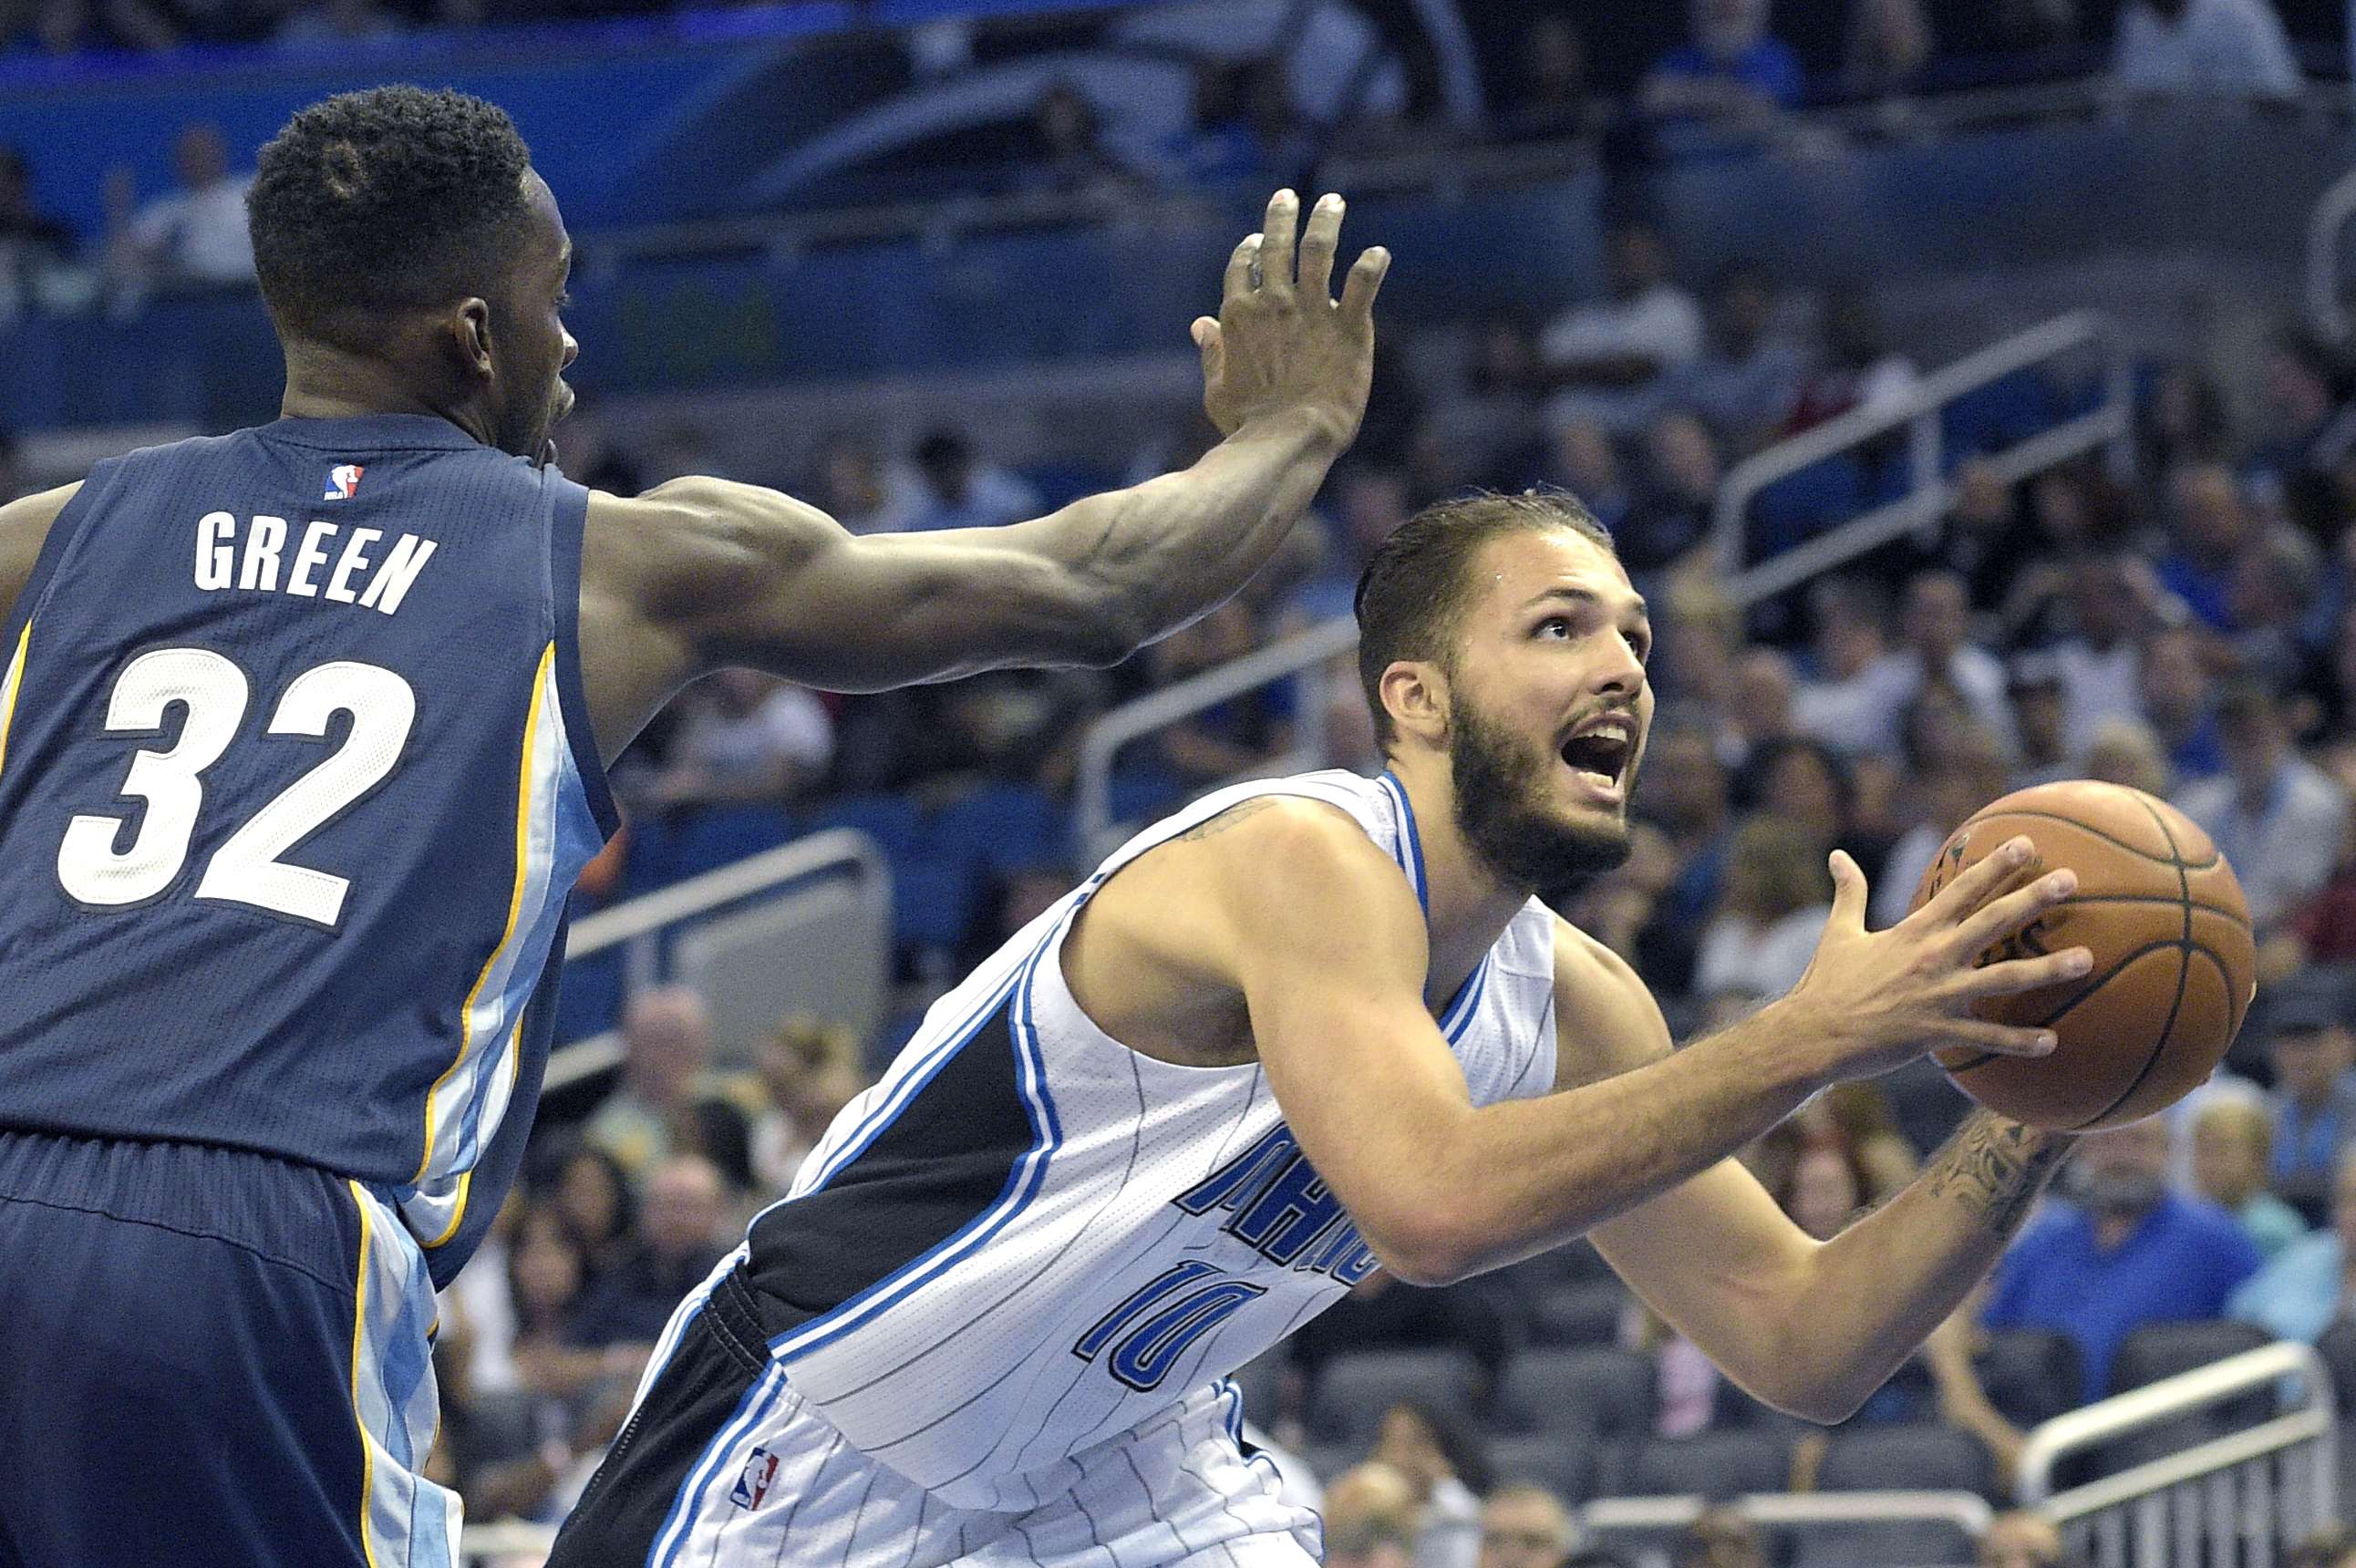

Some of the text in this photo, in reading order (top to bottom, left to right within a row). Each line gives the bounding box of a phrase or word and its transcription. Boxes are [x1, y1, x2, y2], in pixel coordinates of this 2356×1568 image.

[193, 511, 439, 616] GREEN
[57, 646, 417, 927] 32
[1070, 1259, 1269, 1393] 10
